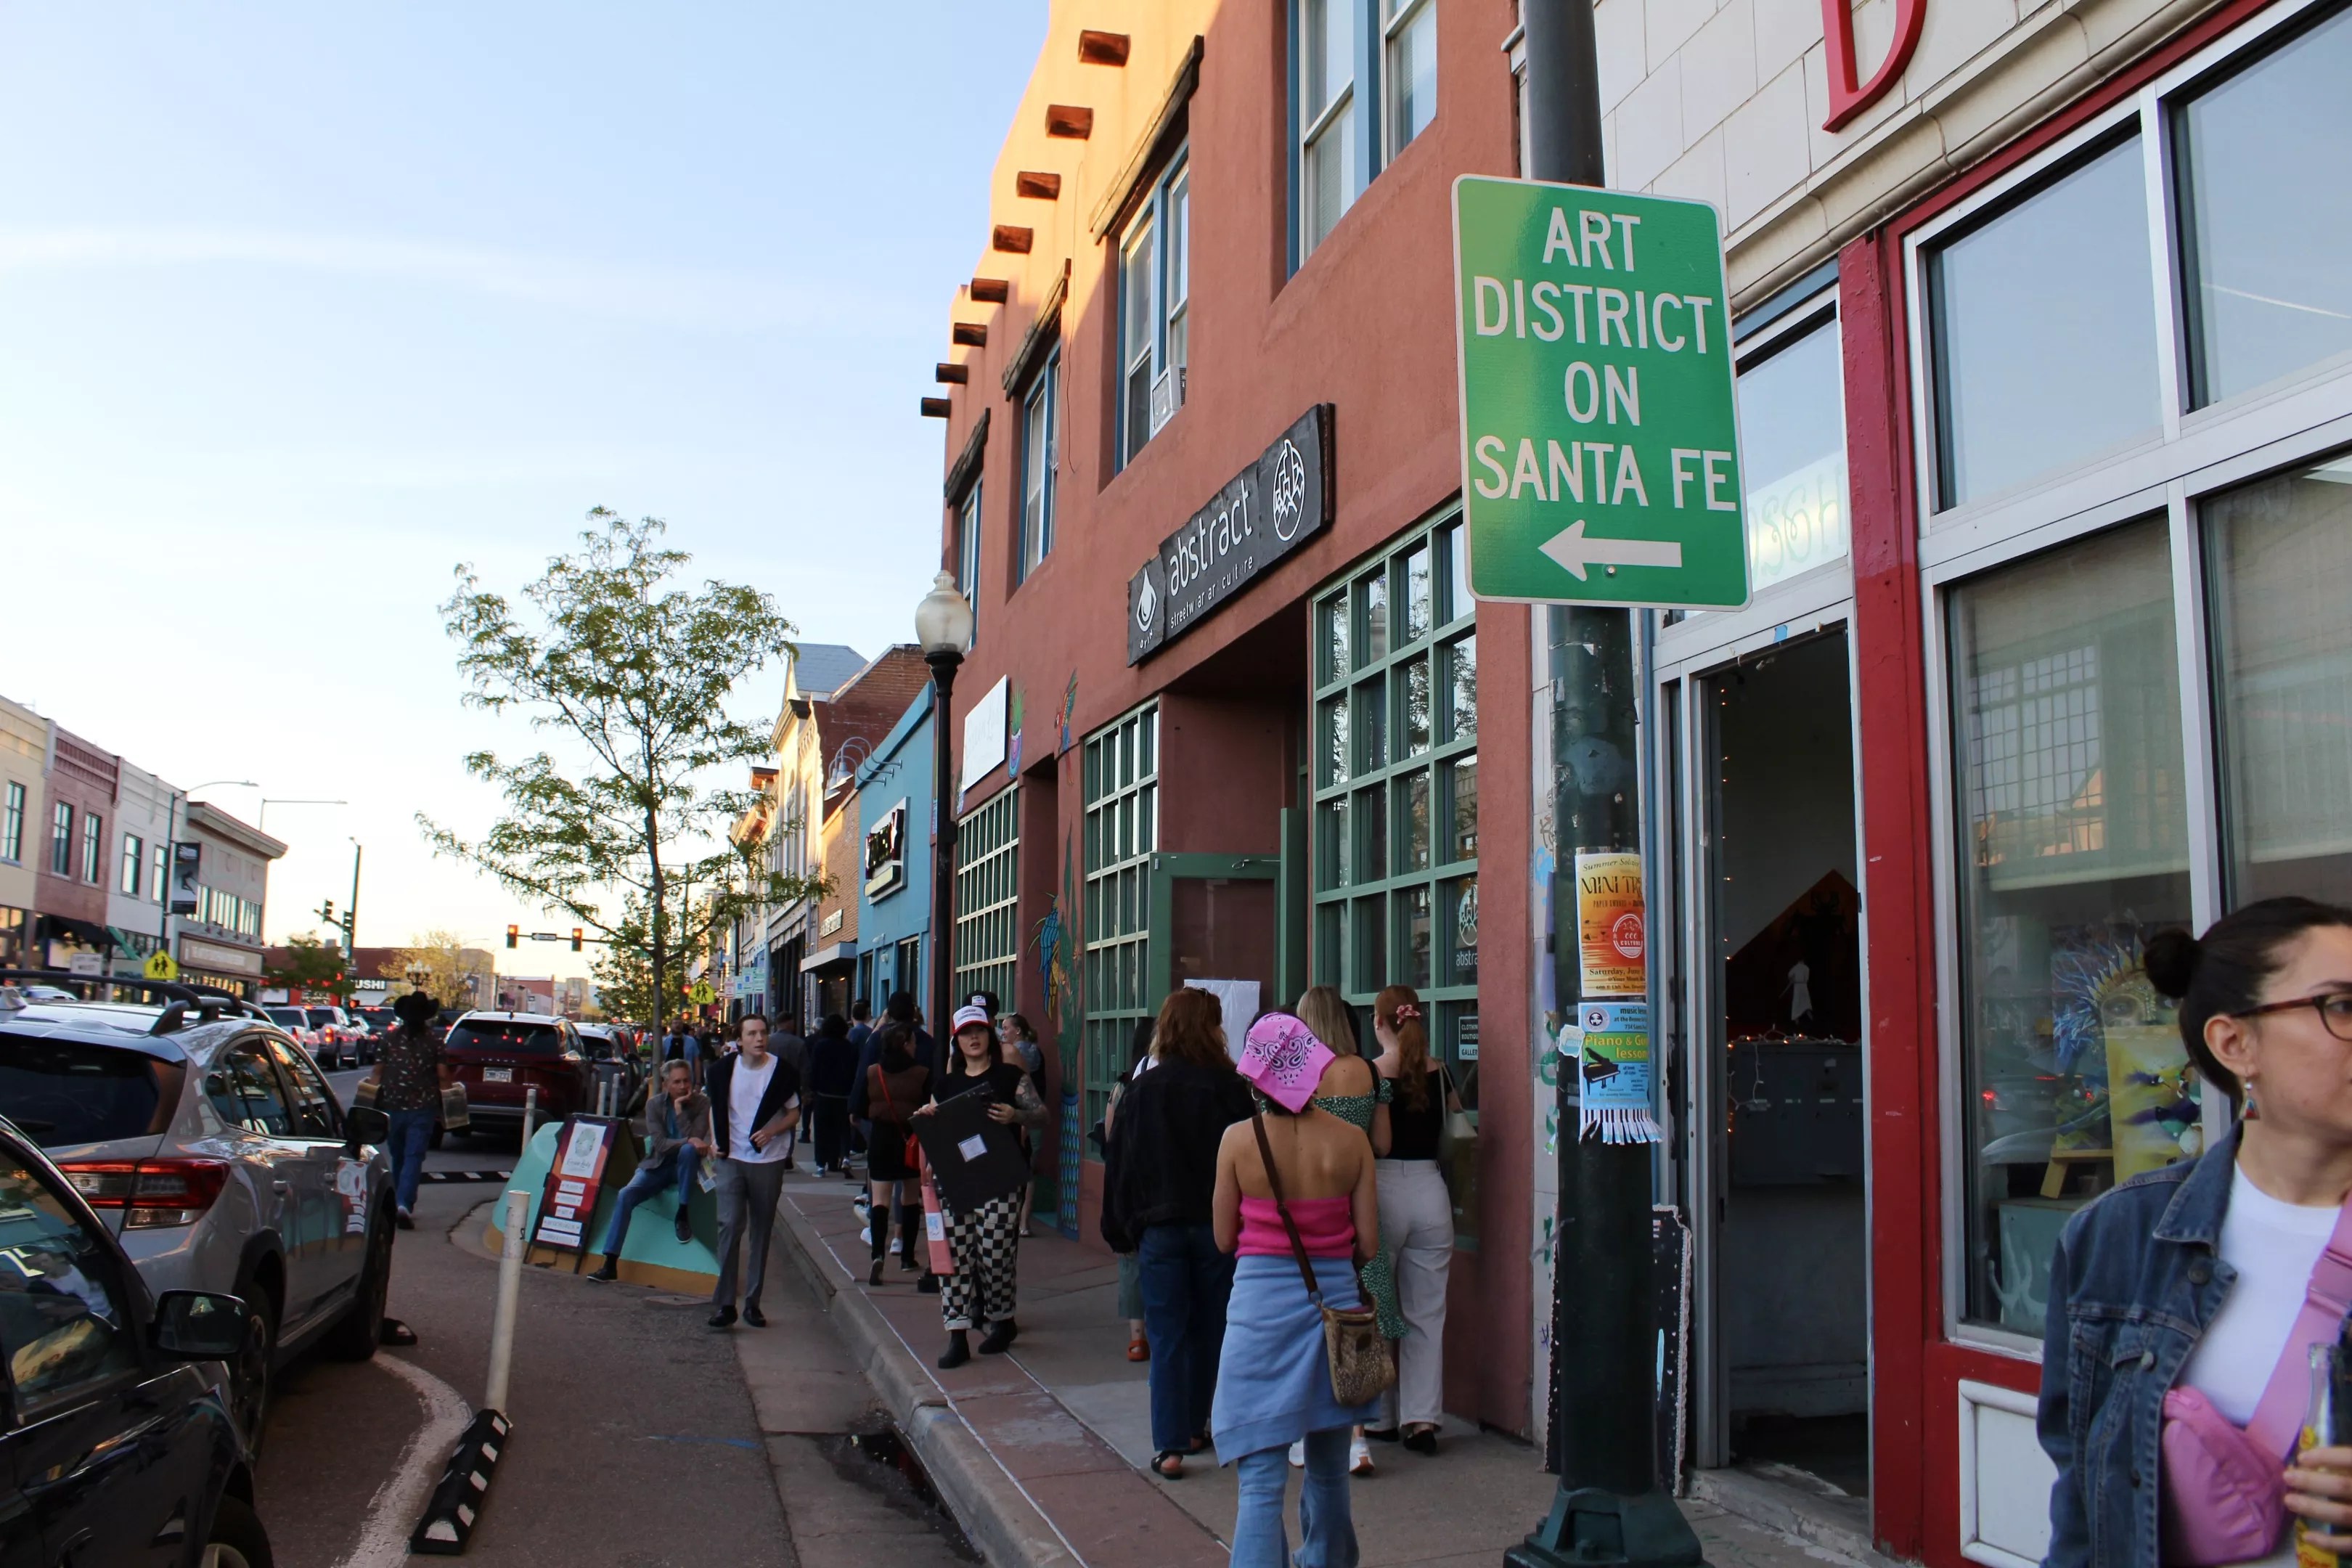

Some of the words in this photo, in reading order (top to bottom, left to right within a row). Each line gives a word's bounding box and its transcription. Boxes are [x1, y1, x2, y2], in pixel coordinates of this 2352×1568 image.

[1542, 207, 1641, 271] ART
[1474, 276, 1712, 354] DISTRICT
[1564, 361, 1641, 426] ON
[1474, 436, 1649, 507] SANTA
[1671, 448, 1736, 512] FE
[1169, 479, 1252, 596] abstract
[1170, 592, 1204, 629] streetwar
[1222, 556, 1254, 589] cutre
[1582, 875, 1619, 895] MINI
[1583, 860, 1617, 871] Summer
[351, 979, 385, 989] USHI
[1620, 1005, 1637, 1014] music
[1585, 1035, 1622, 1045] Piano
[1626, 1037, 1632, 1045] &
